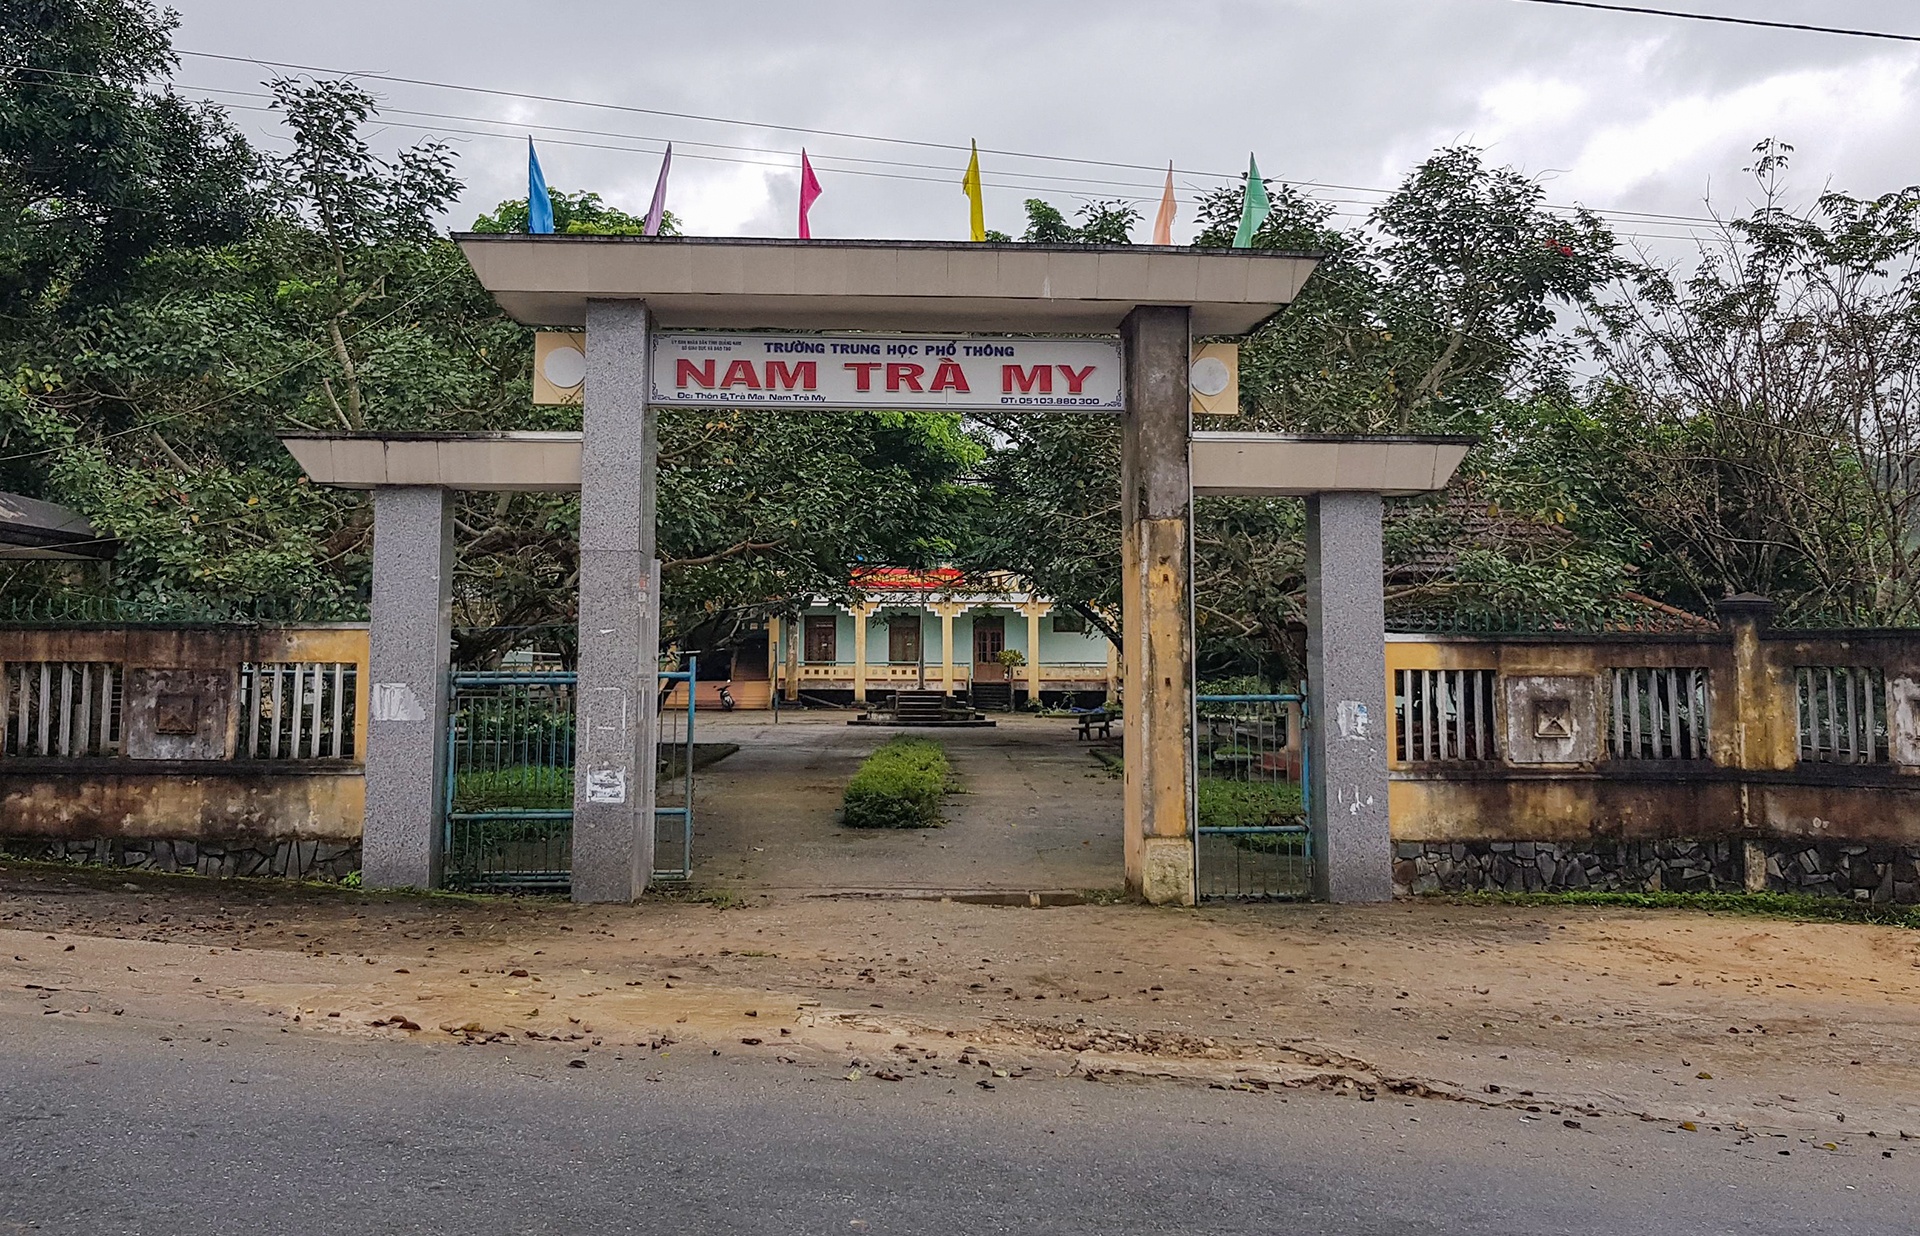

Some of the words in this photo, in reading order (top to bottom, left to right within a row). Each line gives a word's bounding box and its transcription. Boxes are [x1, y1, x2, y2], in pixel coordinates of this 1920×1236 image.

[764, 340, 825, 354] TRƯỜNG
[830, 343, 880, 355] TRUNG
[887, 344, 918, 358] HỌC
[925, 340, 957, 356] PHỔ
[963, 344, 1015, 357] THÔNG
[676, 358, 817, 391] NAM
[843, 357, 971, 393] TRÀ
[1001, 364, 1097, 394] MY
[811, 394, 826, 402] My
